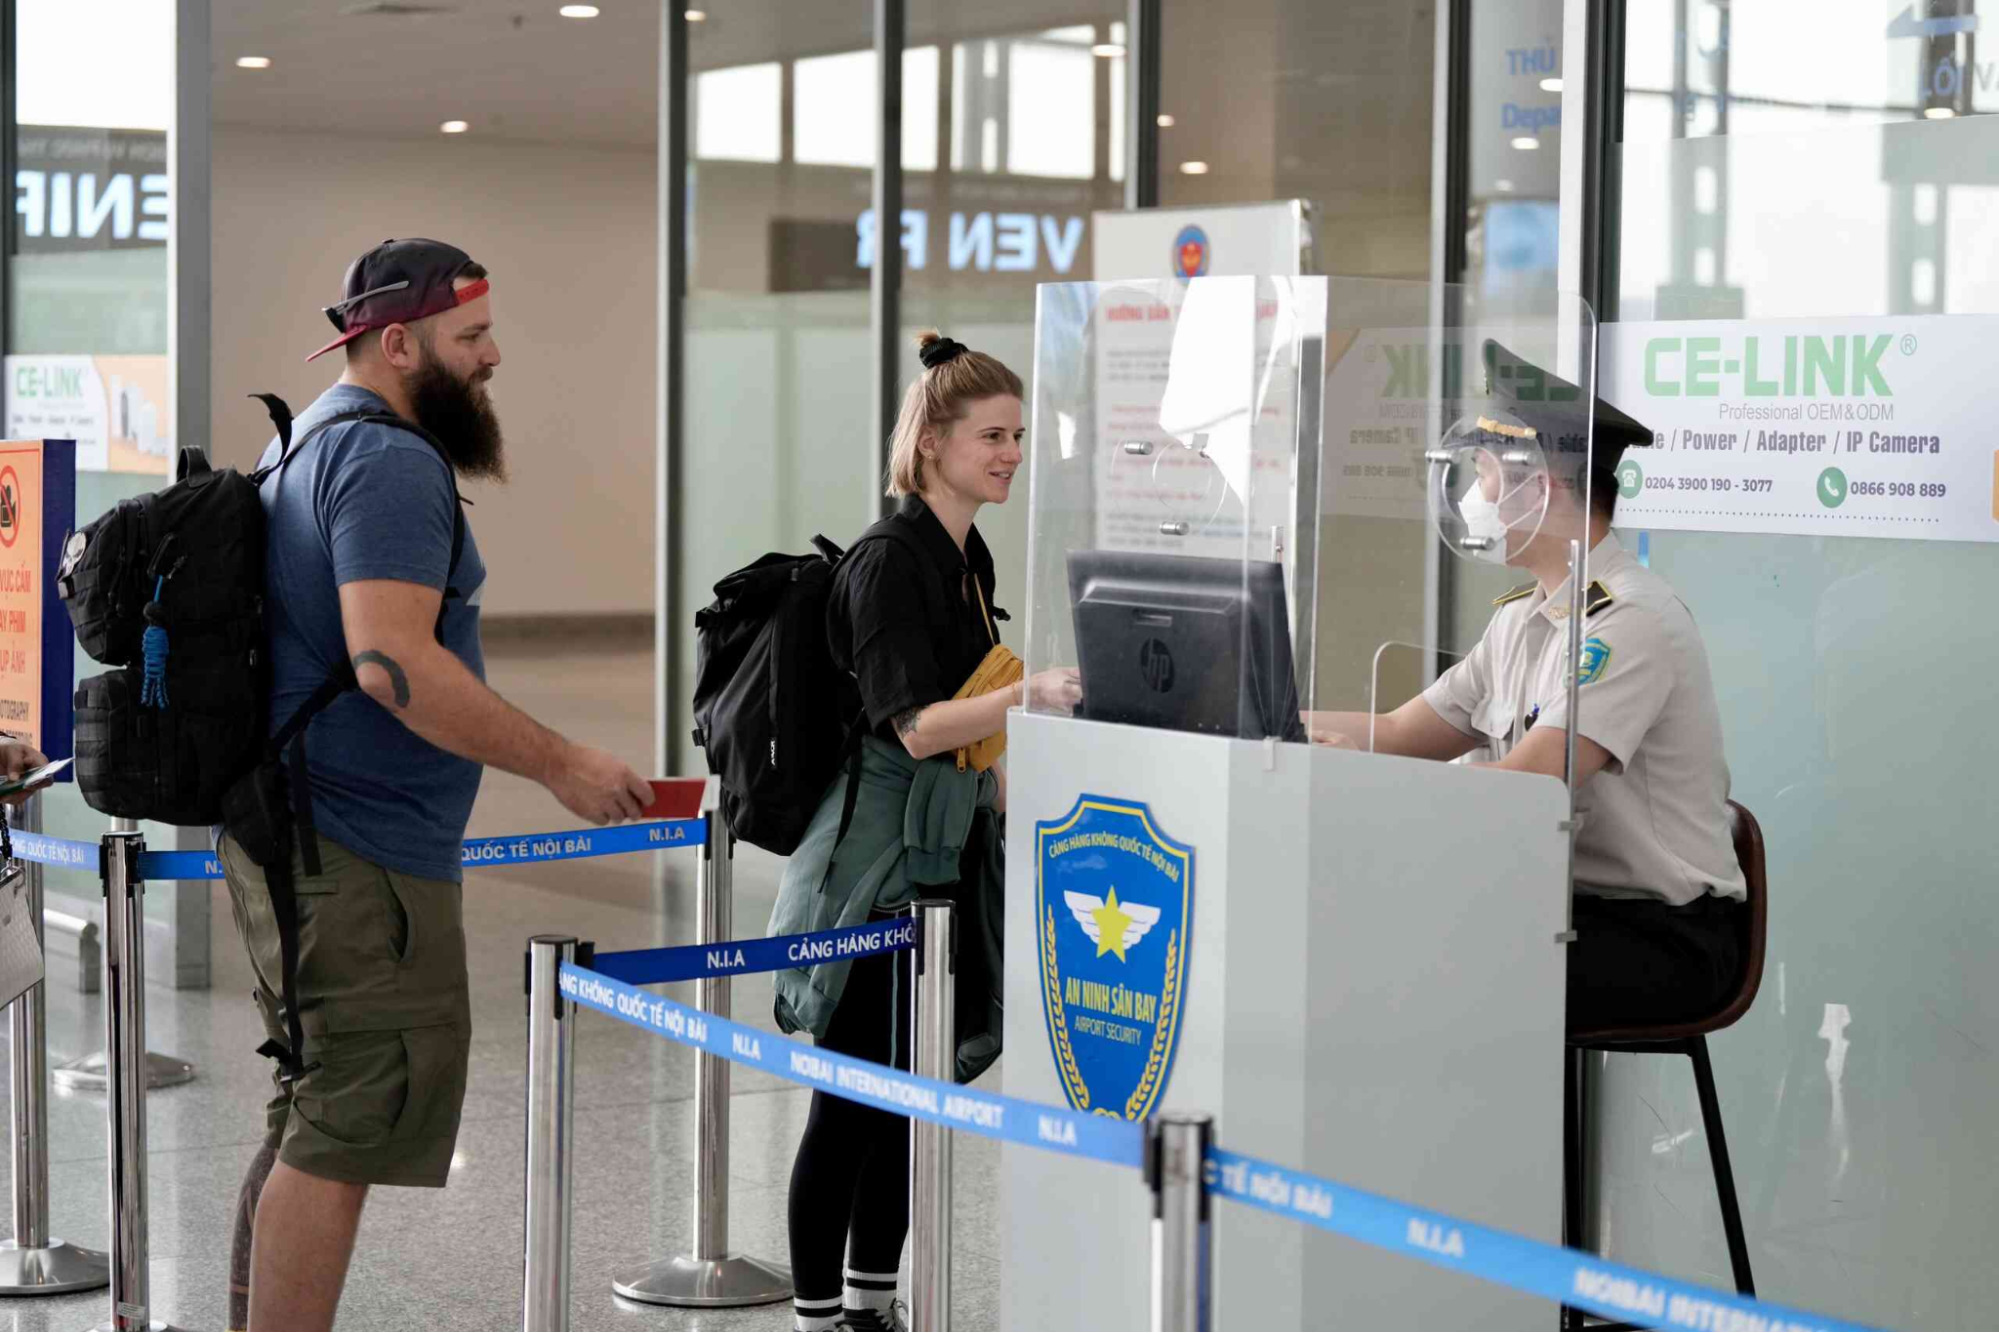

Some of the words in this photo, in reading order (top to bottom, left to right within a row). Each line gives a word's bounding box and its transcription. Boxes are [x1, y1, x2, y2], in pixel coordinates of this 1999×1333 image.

[1974, 61, 1999, 92] V
[1644, 334, 1894, 397] CE-LINK
[16, 366, 82, 398] CE-LINK
[1719, 403, 1802, 420] Professional
[1807, 403, 1894, 421] OEM&ODM
[1682, 430, 1737, 451] Power
[1756, 431, 1827, 454] Adapter
[1846, 431, 1863, 452] IP
[1869, 432, 1941, 454] Camera
[1645, 477, 1675, 490] 0204
[1677, 477, 1708, 491] 3900
[1711, 478, 1731, 491] 190
[1742, 479, 1773, 492] 3077
[1850, 481, 1885, 495] 0866
[1888, 482, 1916, 496] 908
[1919, 482, 1947, 497] 889
[461, 840, 506, 860] QUỐC
[509, 838, 530, 857] TẾ
[532, 836, 562, 858] NỘI
[649, 827, 685, 841] N.I.A
[707, 950, 745, 968] N.I.A
[788, 940, 832, 961] CẢNG
[836, 932, 880, 955] HÀNG
[1065, 976, 1081, 1006] AN
[1082, 980, 1110, 1013] NINH
[1111, 982, 1134, 1019] SÂN
[1134, 991, 1157, 1024] BAY
[1074, 1015, 1106, 1037] AIRPORT
[1106, 1022, 1142, 1046] SECURITY
[836, 1064, 939, 1114] INTERNATIONAL
[941, 1093, 1004, 1130] AIRPORT
